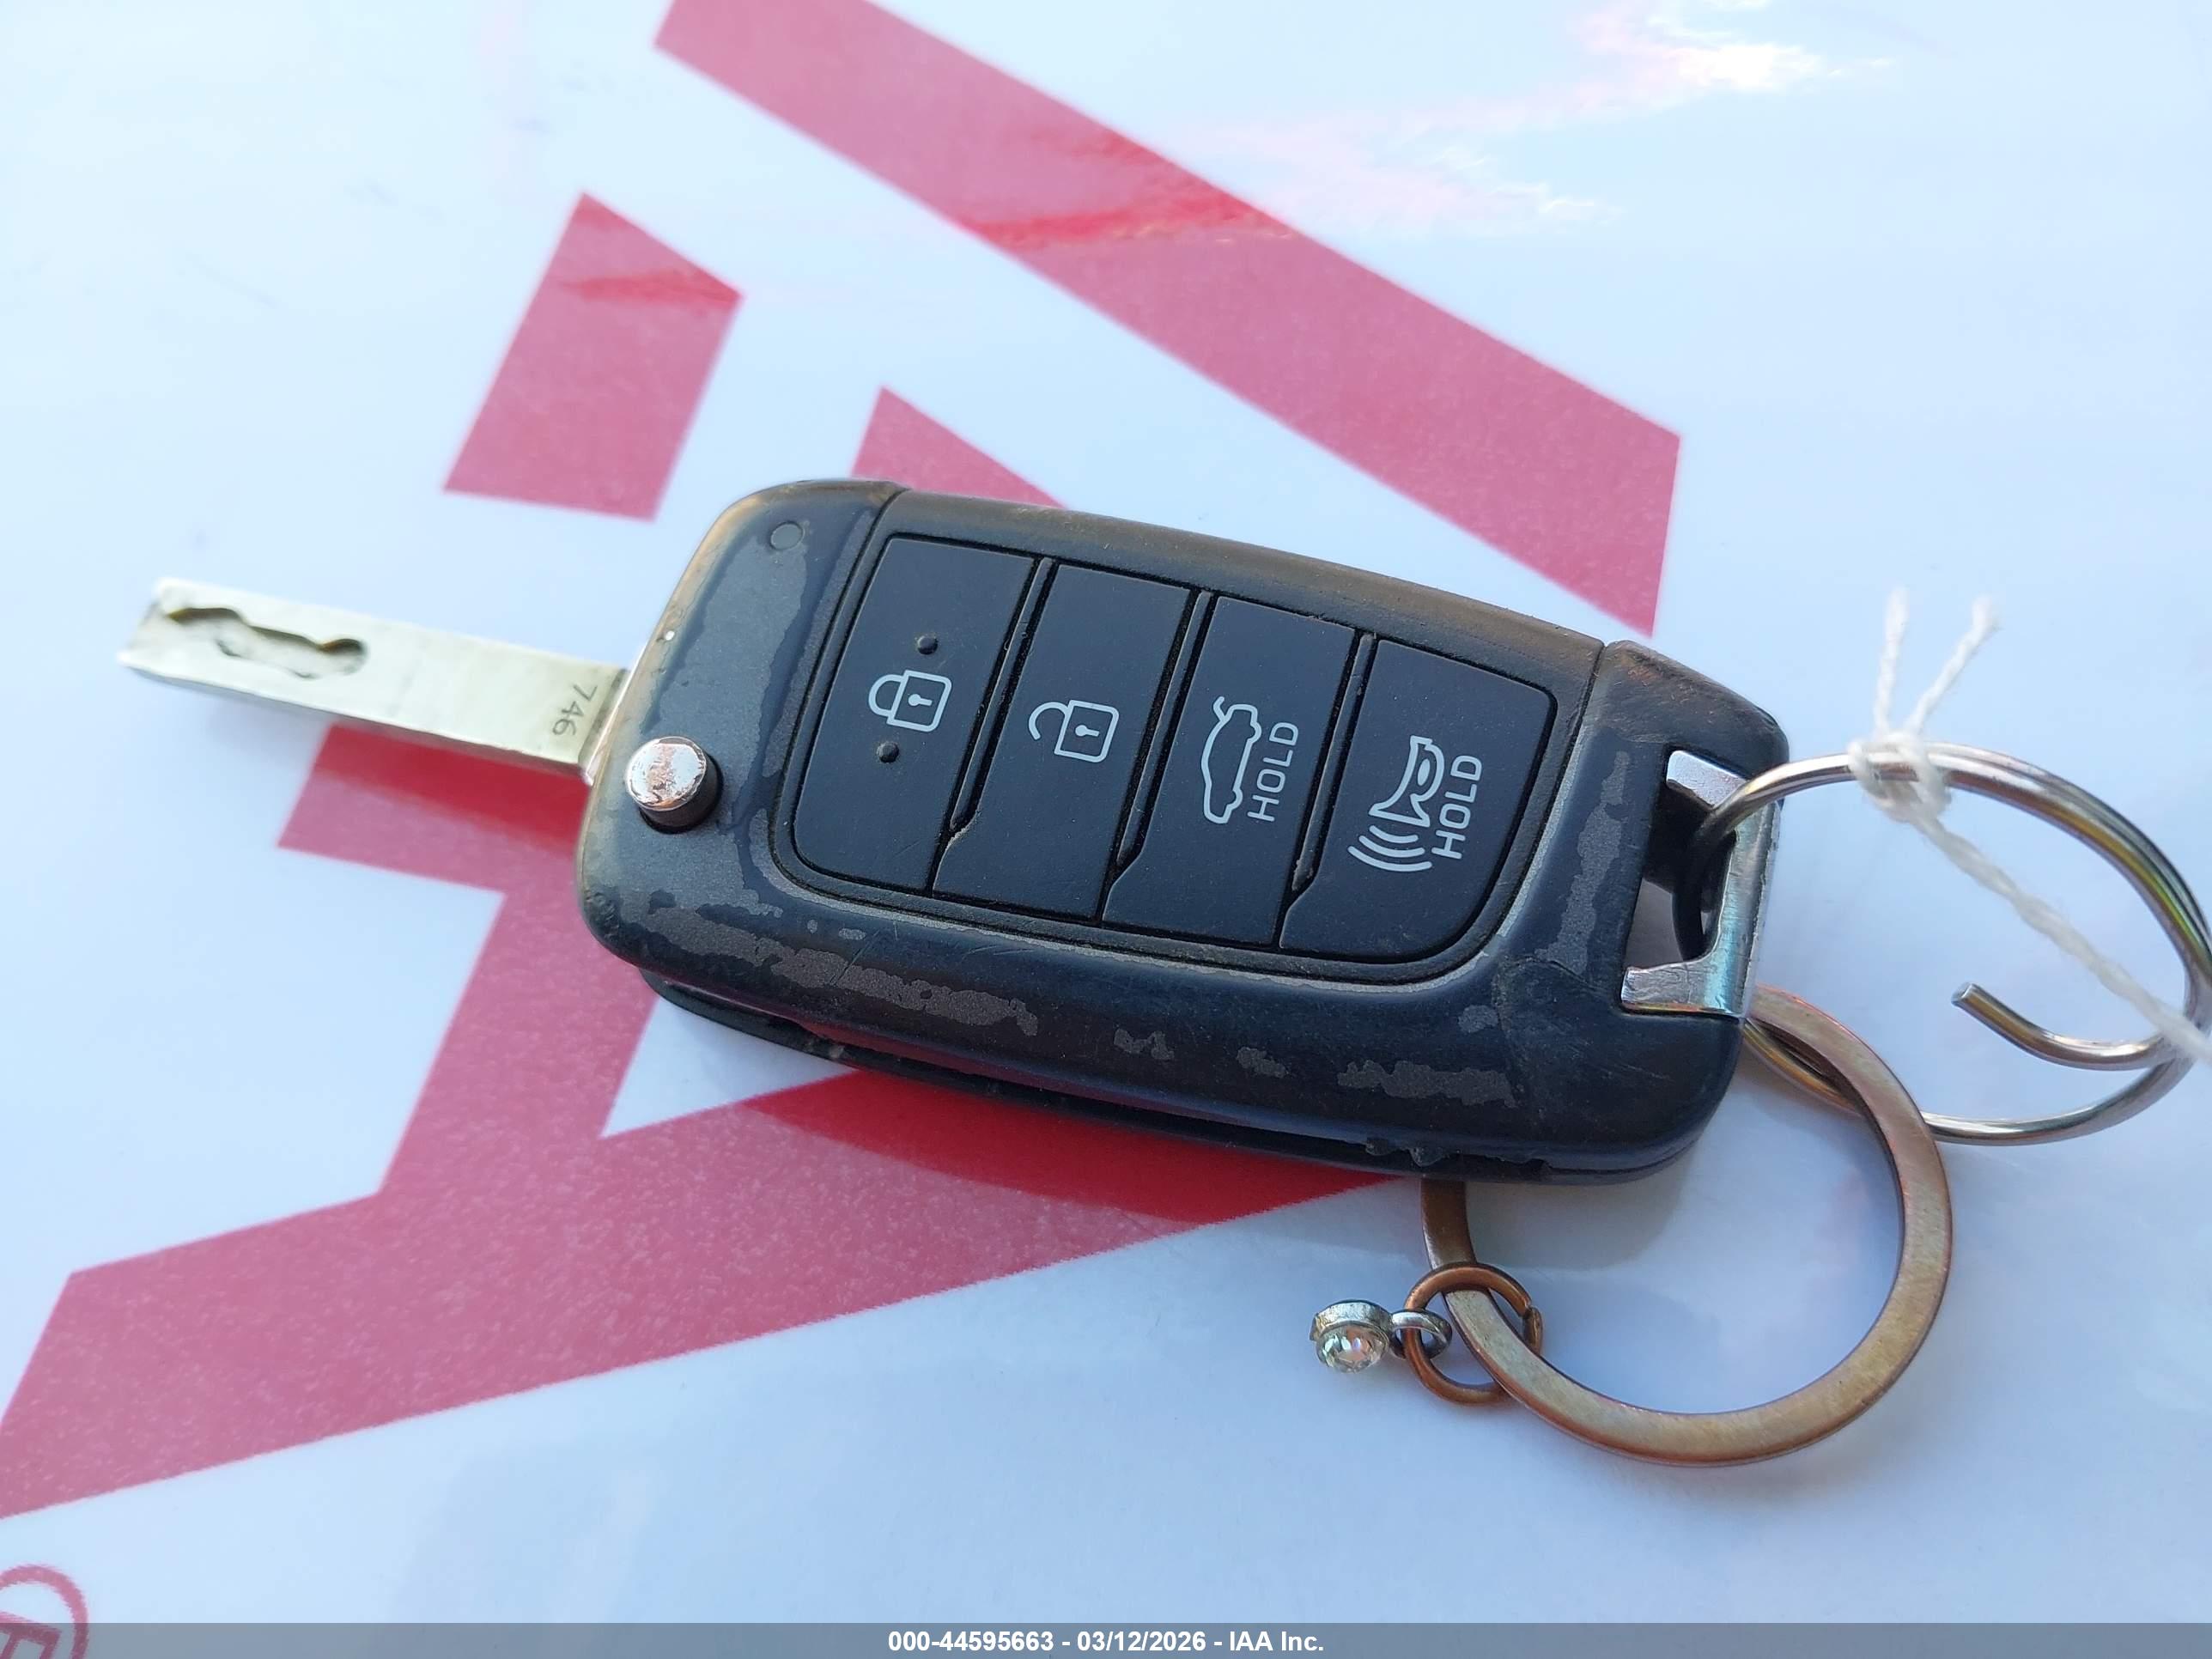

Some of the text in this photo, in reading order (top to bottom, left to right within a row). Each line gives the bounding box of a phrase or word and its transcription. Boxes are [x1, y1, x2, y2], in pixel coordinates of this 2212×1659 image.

[551, 684, 599, 736] 746
[1247, 721, 1299, 823] HOLD
[1431, 755, 1483, 860] HOLD
